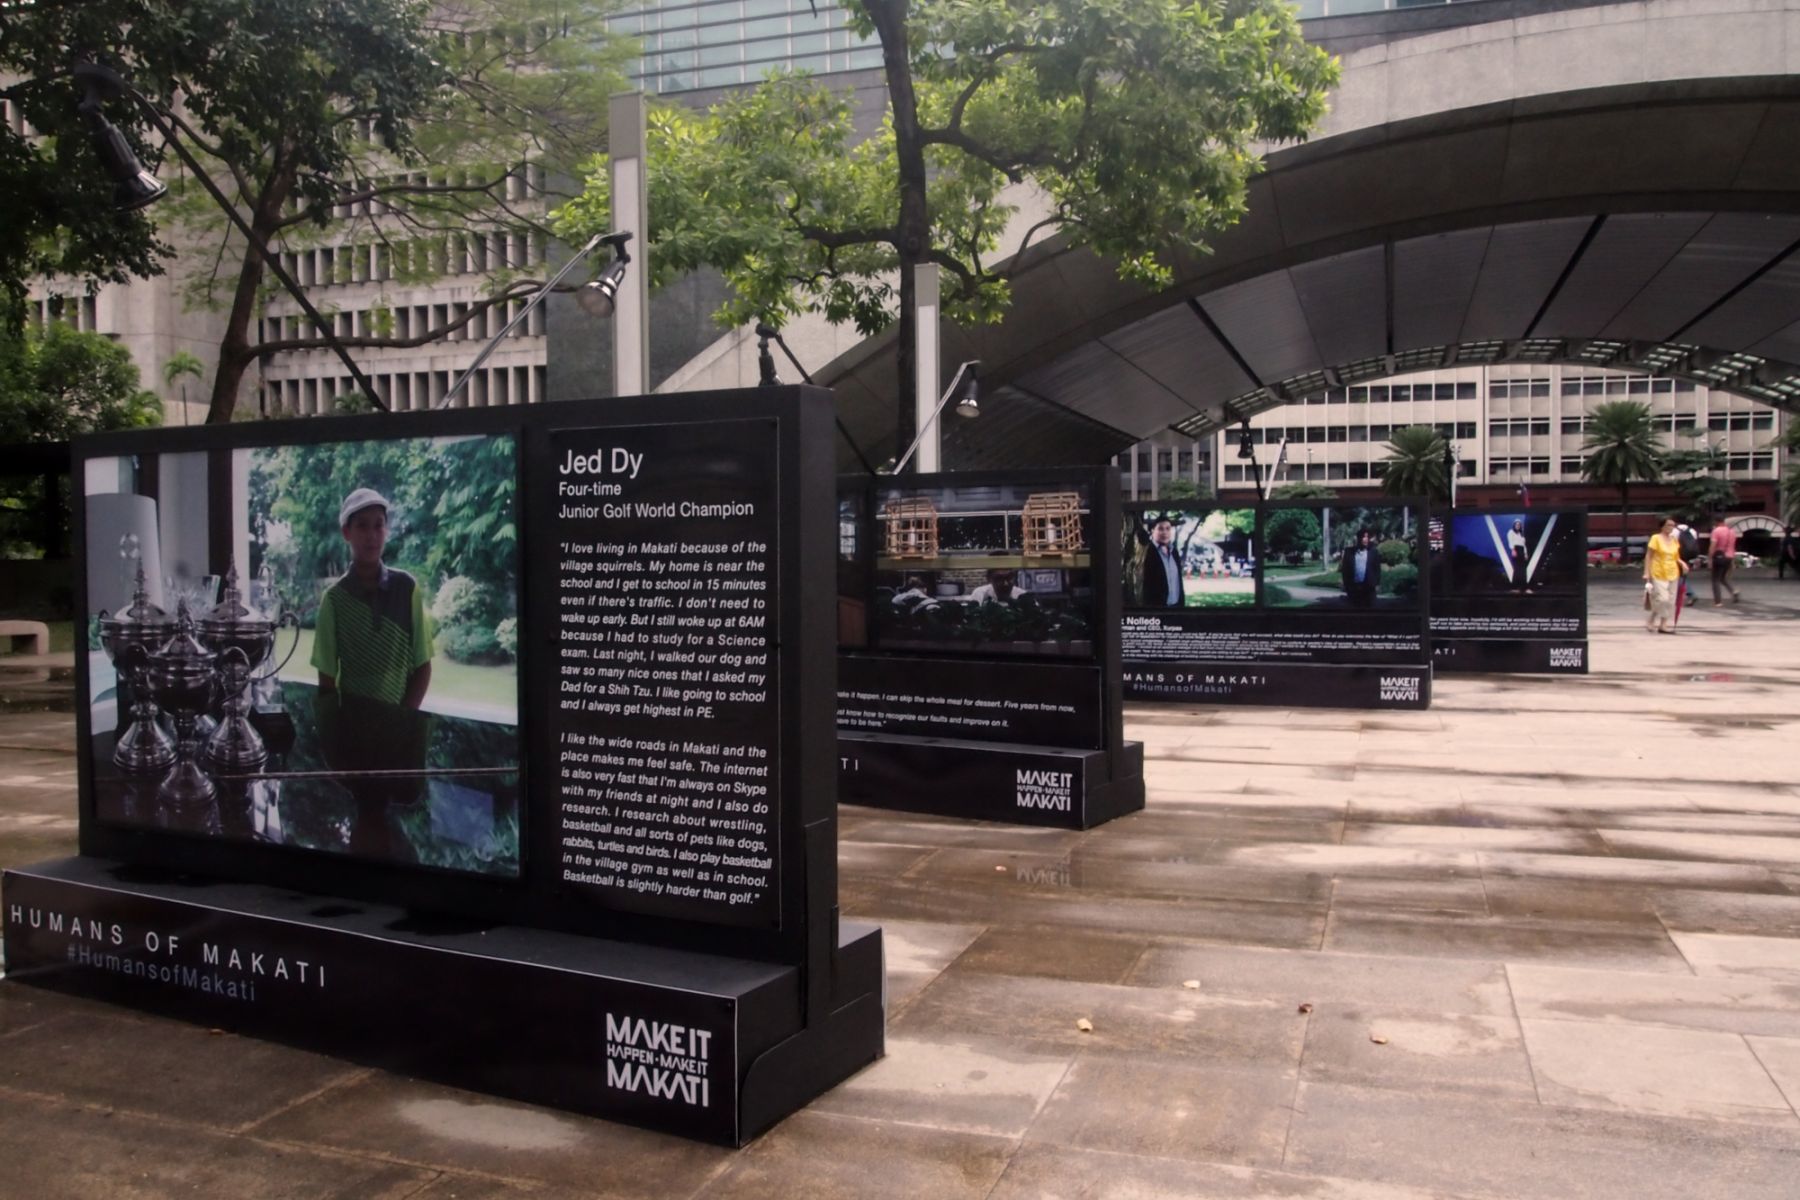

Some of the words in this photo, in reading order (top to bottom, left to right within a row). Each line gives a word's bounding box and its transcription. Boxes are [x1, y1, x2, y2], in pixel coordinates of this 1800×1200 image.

[559, 448, 602, 474] Jed
[611, 447, 643, 479] Dy
[558, 481, 621, 496] Four-time
[558, 503, 599, 518] Junior
[602, 503, 631, 518] Golf
[634, 502, 675, 517] World
[679, 500, 753, 519] Champion
[571, 542, 593, 553] love
[596, 542, 624, 555] living
[627, 542, 637, 553] in
[640, 542, 677, 553] Makati
[680, 542, 728, 553] because
[731, 540, 744, 553] of
[747, 541, 766, 552] the
[560, 560, 593, 573] village
[596, 560, 645, 573] squirrels.
[648, 560, 666, 574] My
[668, 560, 700, 572] home
[702, 560, 713, 572] is
[716, 562, 743, 572] near
[746, 560, 765, 571] the
[560, 577, 593, 588] school
[594, 578, 614, 589] and
[615, 578, 620, 588] I
[622, 579, 639, 592] get
[641, 579, 653, 589] to
[654, 578, 691, 590] school
[692, 578, 703, 589] in
[707, 578, 719, 590] 15
[722, 578, 766, 590] minutes
[560, 596, 585, 605] even
[587, 595, 596, 605] if
[598, 595, 635, 607] there's
[638, 596, 674, 607] traffic.
[678, 596, 683, 607] I
[685, 596, 716, 608] don't
[719, 597, 749, 609] need
[752, 597, 765, 609] to
[561, 612, 585, 623] wake
[587, 615, 600, 625] up
[602, 613, 627, 627] early.
[630, 613, 648, 625] But
[650, 614, 655, 625] I
[656, 614, 675, 625] still
[677, 615, 705, 627] woke
[707, 617, 722, 629] up
[724, 616, 736, 627] at
[738, 615, 765, 627] 6AM
[560, 629, 604, 641] because
[606, 631, 611, 641] I
[613, 631, 634, 642] had
[637, 632, 649, 643] to
[652, 633, 683, 645] study
[687, 633, 704, 645] for
[706, 636, 714, 645] a
[717, 633, 766, 646] Science
[560, 648, 589, 658] exam.
[592, 648, 615, 659] Last
[617, 649, 646, 663] night,
[650, 650, 654, 660] I
[657, 650, 695, 663] walked
[697, 654, 717, 663] our
[719, 652, 742, 666] dog
[744, 653, 767, 665] and
[1550, 648, 1574, 656] MAKE
[1550, 658, 1581, 666] MAKATI
[560, 665, 581, 675] saw
[582, 666, 595, 676] so
[597, 667, 625, 680] many
[627, 667, 650, 679] nice
[651, 670, 678, 680] ones
[680, 669, 702, 681] that
[705, 670, 709, 681] I
[711, 671, 745, 683] asked
[747, 674, 765, 686] my
[1123, 673, 1165, 682] MANS
[1176, 674, 1194, 682] OF
[1205, 675, 1265, 684] MAKATI
[1380, 677, 1410, 687] MAKE
[1411, 677, 1420, 687] IT
[560, 680, 581, 692] Dad
[583, 681, 597, 693] for
[598, 685, 605, 694] a
[607, 683, 630, 695] Shih
[632, 684, 652, 696] Tzu.
[655, 686, 660, 697] I
[661, 686, 680, 698] like
[682, 688, 713, 702] going
[715, 689, 726, 700] to
[728, 690, 766, 702] school
[1133, 683, 1232, 693] #HumansofMakati
[1380, 691, 1418, 700] MAKATI
[560, 699, 580, 709] and
[581, 699, 586, 709] I
[587, 700, 621, 714] always
[623, 703, 640, 715] get
[642, 703, 681, 717] highest
[683, 705, 694, 716] in
[696, 705, 714, 718] PE.
[1017, 769, 1058, 788] MAKE
[1060, 772, 1072, 788] IT
[1017, 792, 1071, 811] MAKATI
[11, 904, 123, 945] HUMANS
[145, 932, 178, 954] OF
[204, 942, 324, 987] MAKATI
[67, 943, 255, 1001] #HumansofMakati
[606, 1012, 685, 1055] MAKE
[689, 1028, 711, 1060] IT
[607, 1043, 654, 1065] HAPPEN
[660, 1054, 696, 1073] MAKE
[698, 1061, 708, 1075] IT
[607, 1059, 709, 1107] MAKATI
